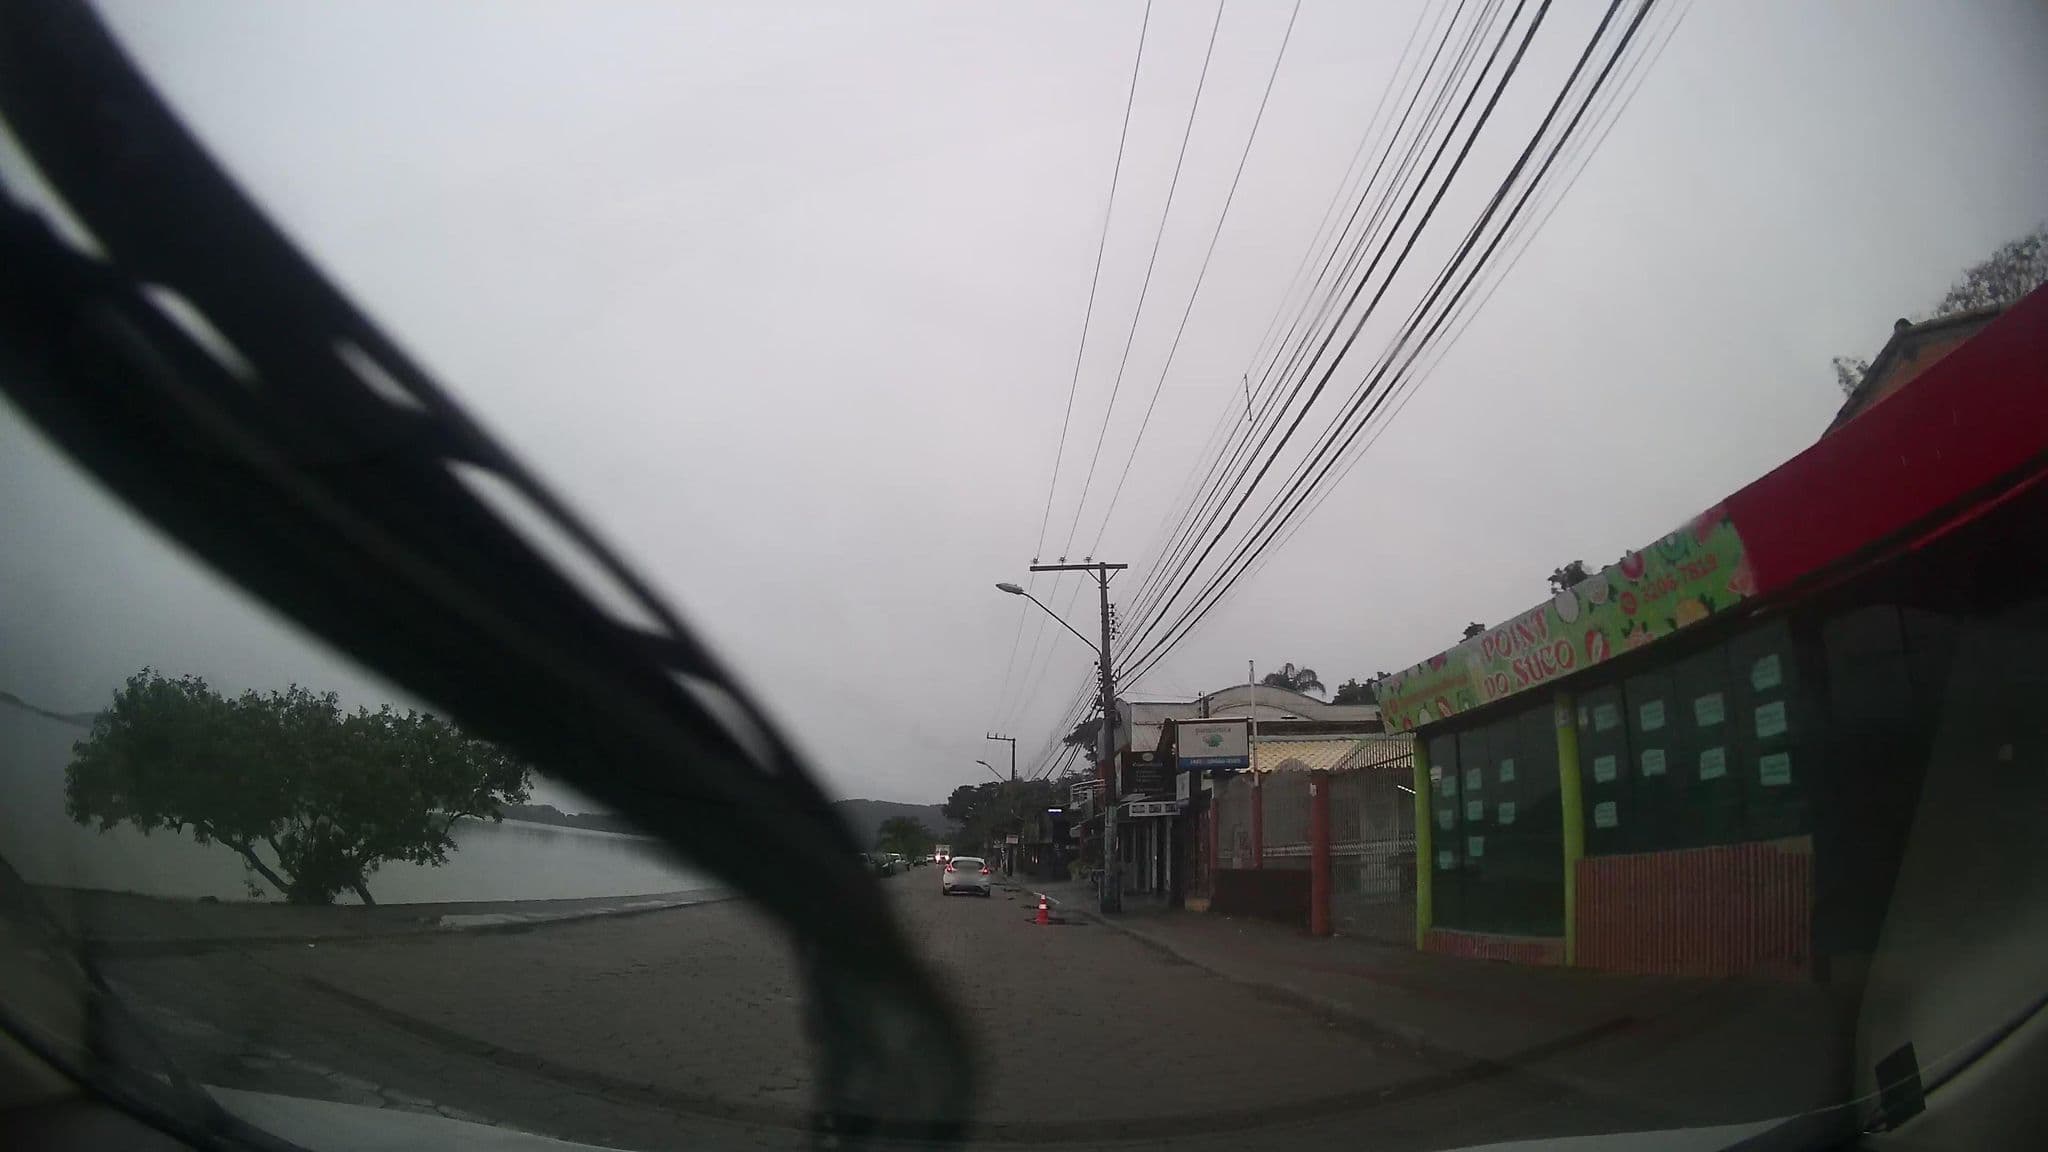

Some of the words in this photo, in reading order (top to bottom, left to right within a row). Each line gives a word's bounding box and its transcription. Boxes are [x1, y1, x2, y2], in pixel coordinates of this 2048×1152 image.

[1481, 607, 1548, 662] POINT
[1484, 672, 1509, 699] DO
[1512, 639, 1576, 689] SUCO
